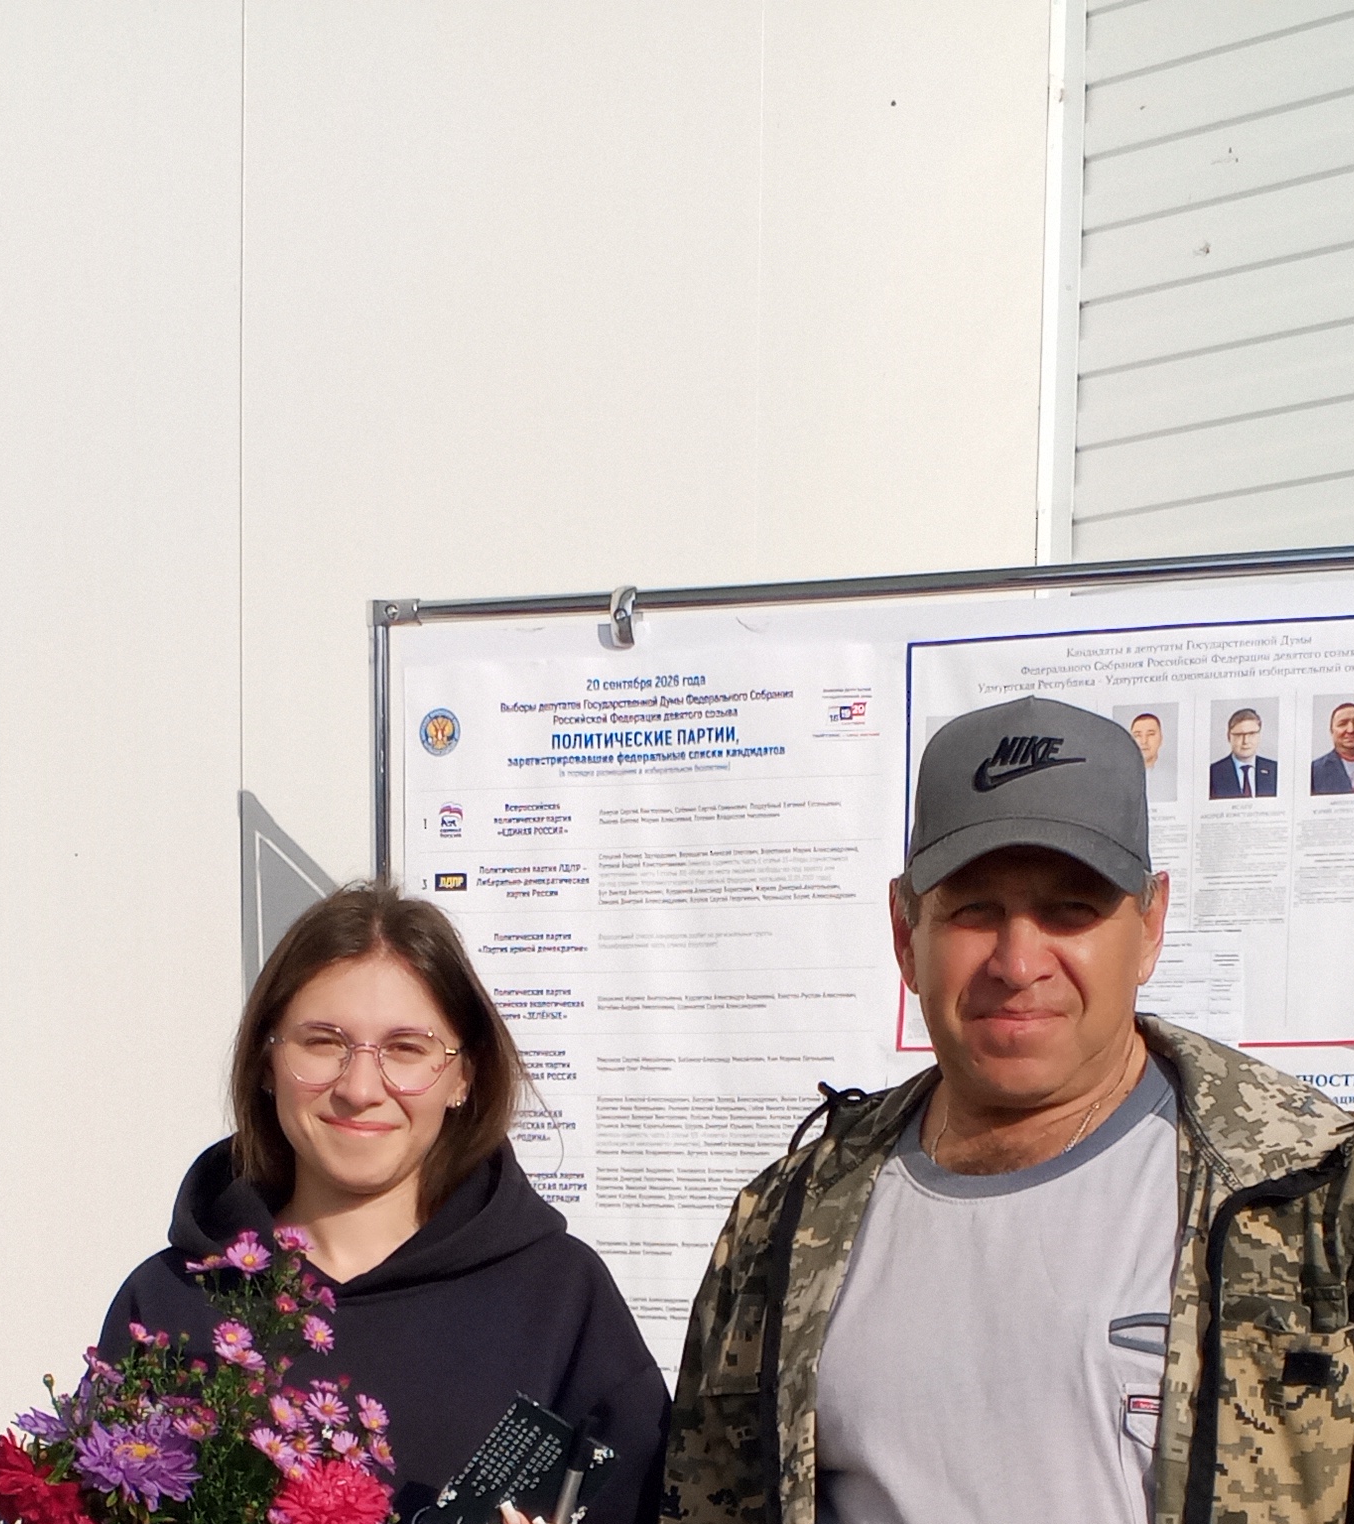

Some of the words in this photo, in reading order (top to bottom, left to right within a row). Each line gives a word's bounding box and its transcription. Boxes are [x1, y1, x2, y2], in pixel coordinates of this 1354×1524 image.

[586, 679, 600, 691] 20
[603, 677, 652, 691] сентября
[683, 675, 706, 688] года
[553, 712, 608, 726] Российской
[551, 729, 672, 750] ПОЛИТИЧЕСКИЕ
[677, 726, 740, 745] ПАРТИИ,
[990, 736, 1064, 767] NIKE
